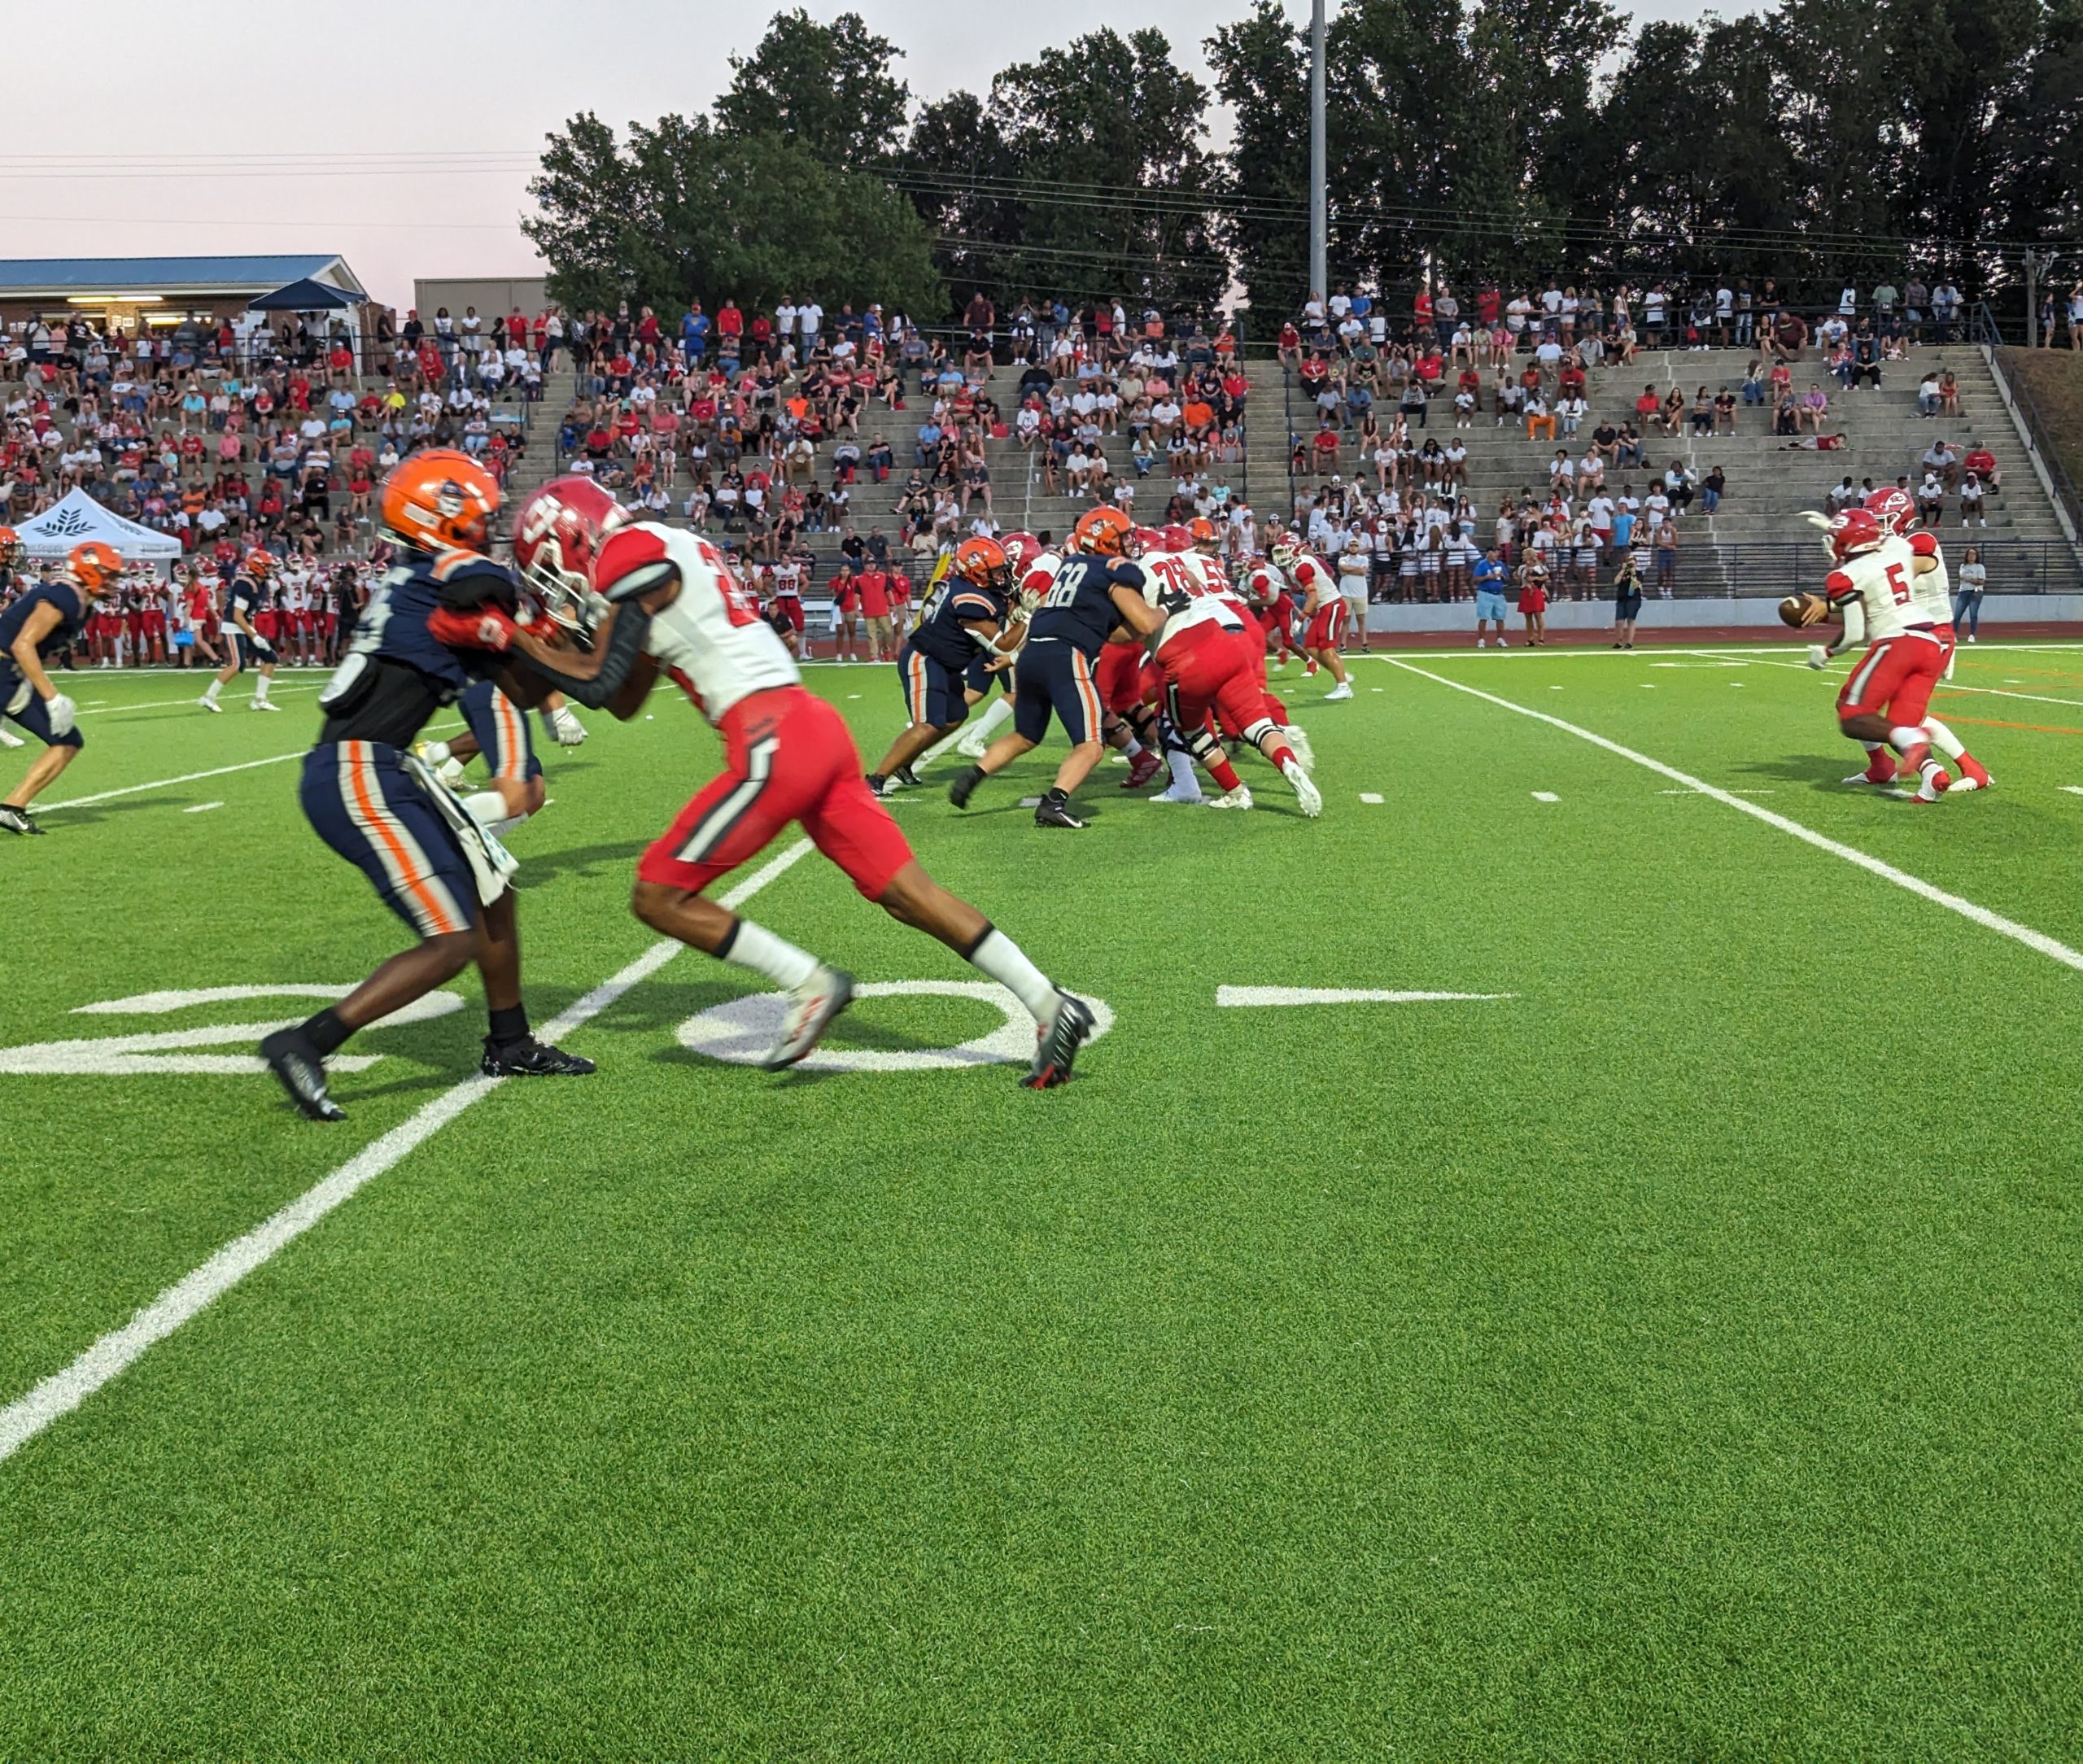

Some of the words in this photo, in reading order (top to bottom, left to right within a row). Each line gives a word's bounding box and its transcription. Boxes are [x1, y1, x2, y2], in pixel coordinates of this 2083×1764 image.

[294, 586, 303, 601] 3
[778, 579, 796, 591] 88
[1043, 562, 1089, 608] 68
[1884, 562, 1912, 606] 5
